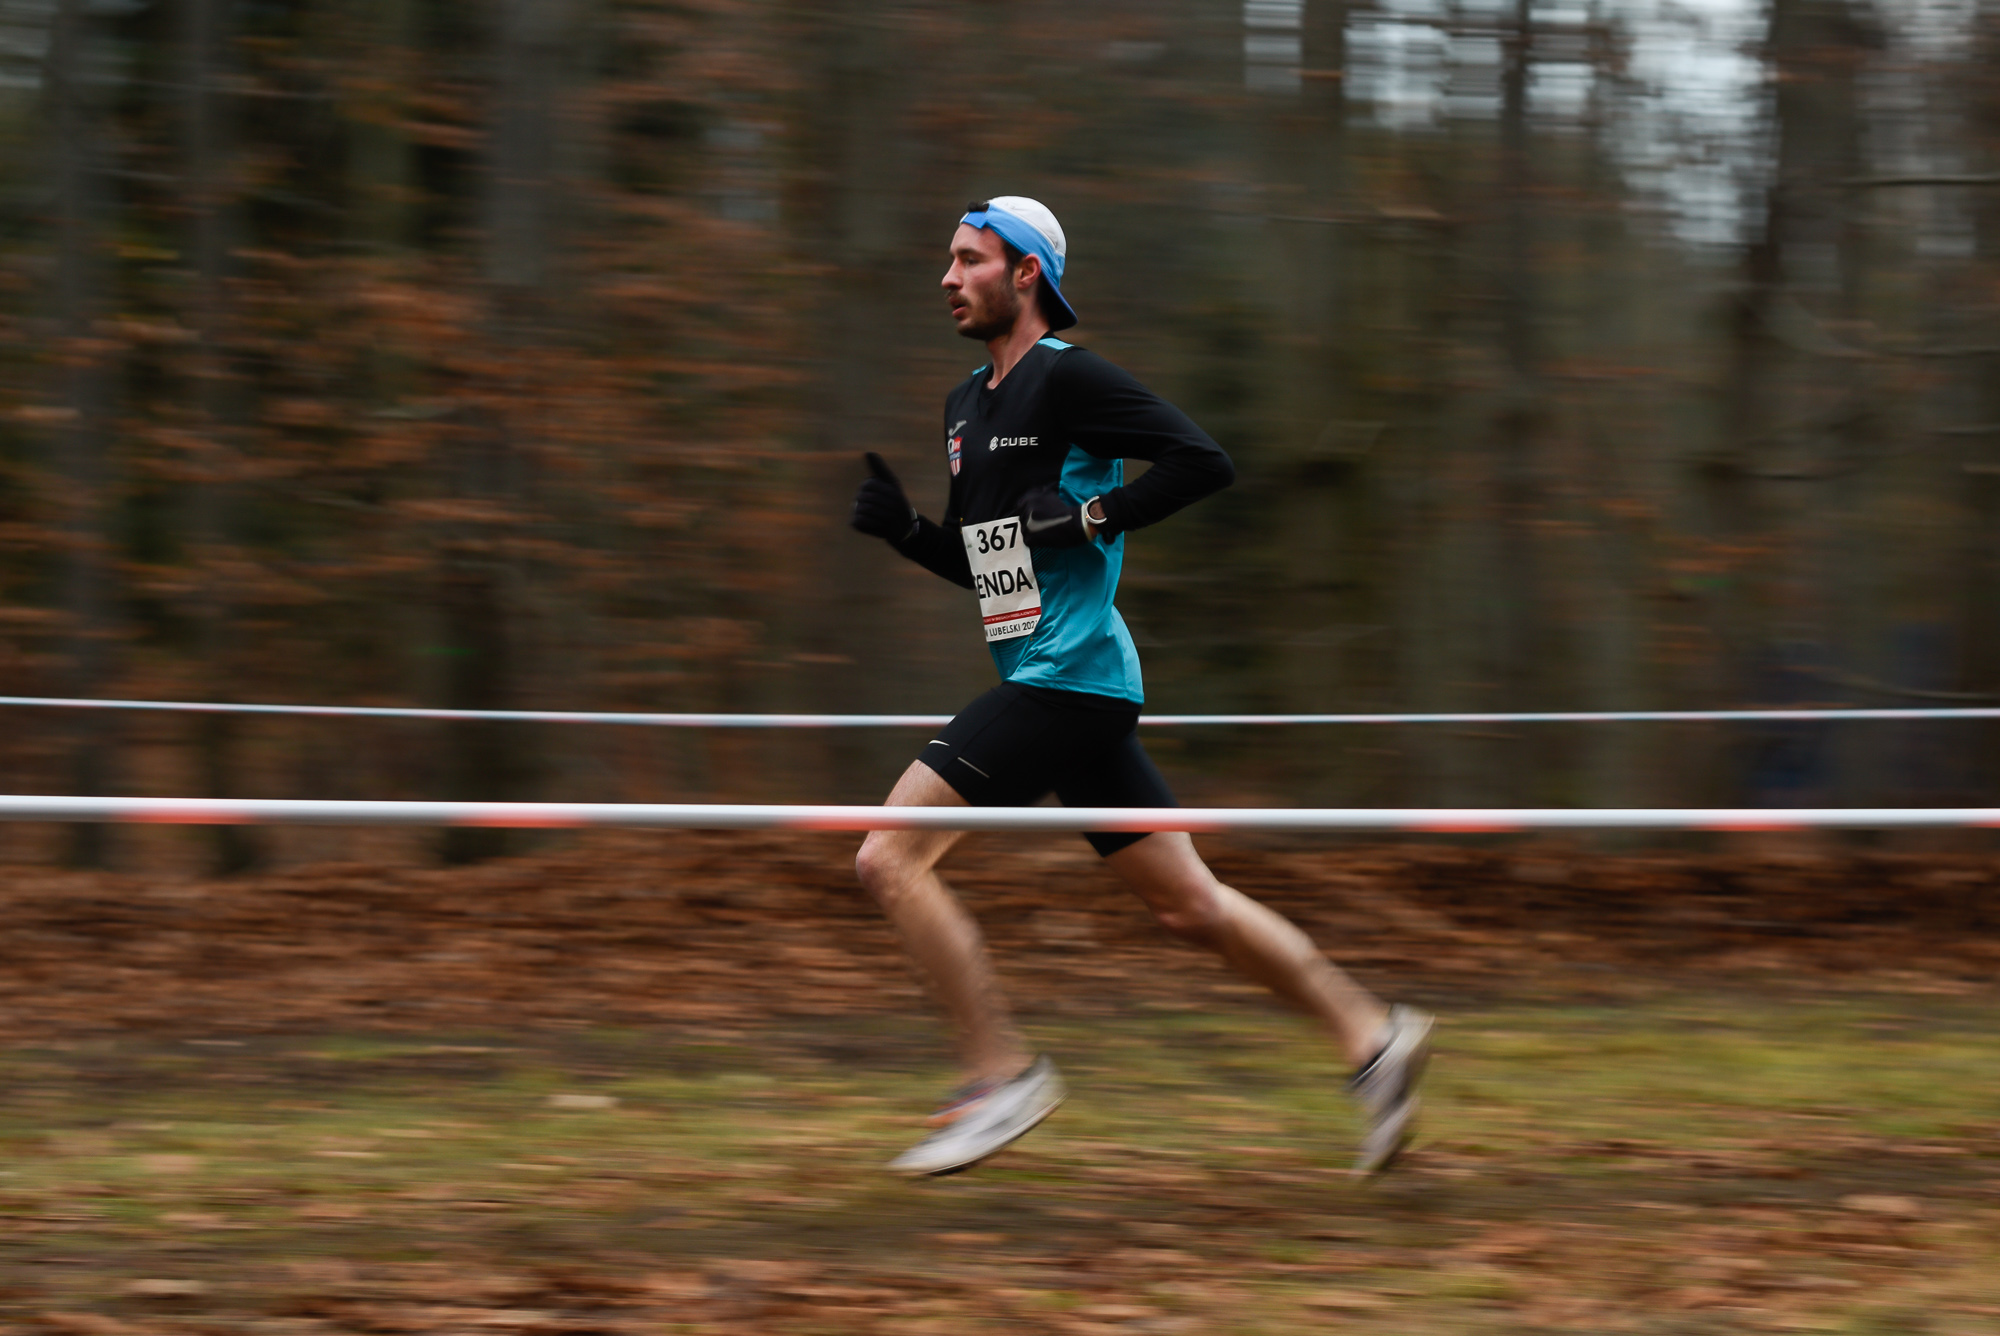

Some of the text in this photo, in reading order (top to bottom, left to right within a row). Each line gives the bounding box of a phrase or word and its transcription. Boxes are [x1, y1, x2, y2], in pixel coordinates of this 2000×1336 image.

[1000, 436, 1039, 447] CUBE
[976, 522, 1019, 554] 367
[975, 566, 1034, 599] ENDA
[990, 623, 1021, 637] LUBELSKI
[1022, 620, 1037, 631] 202
